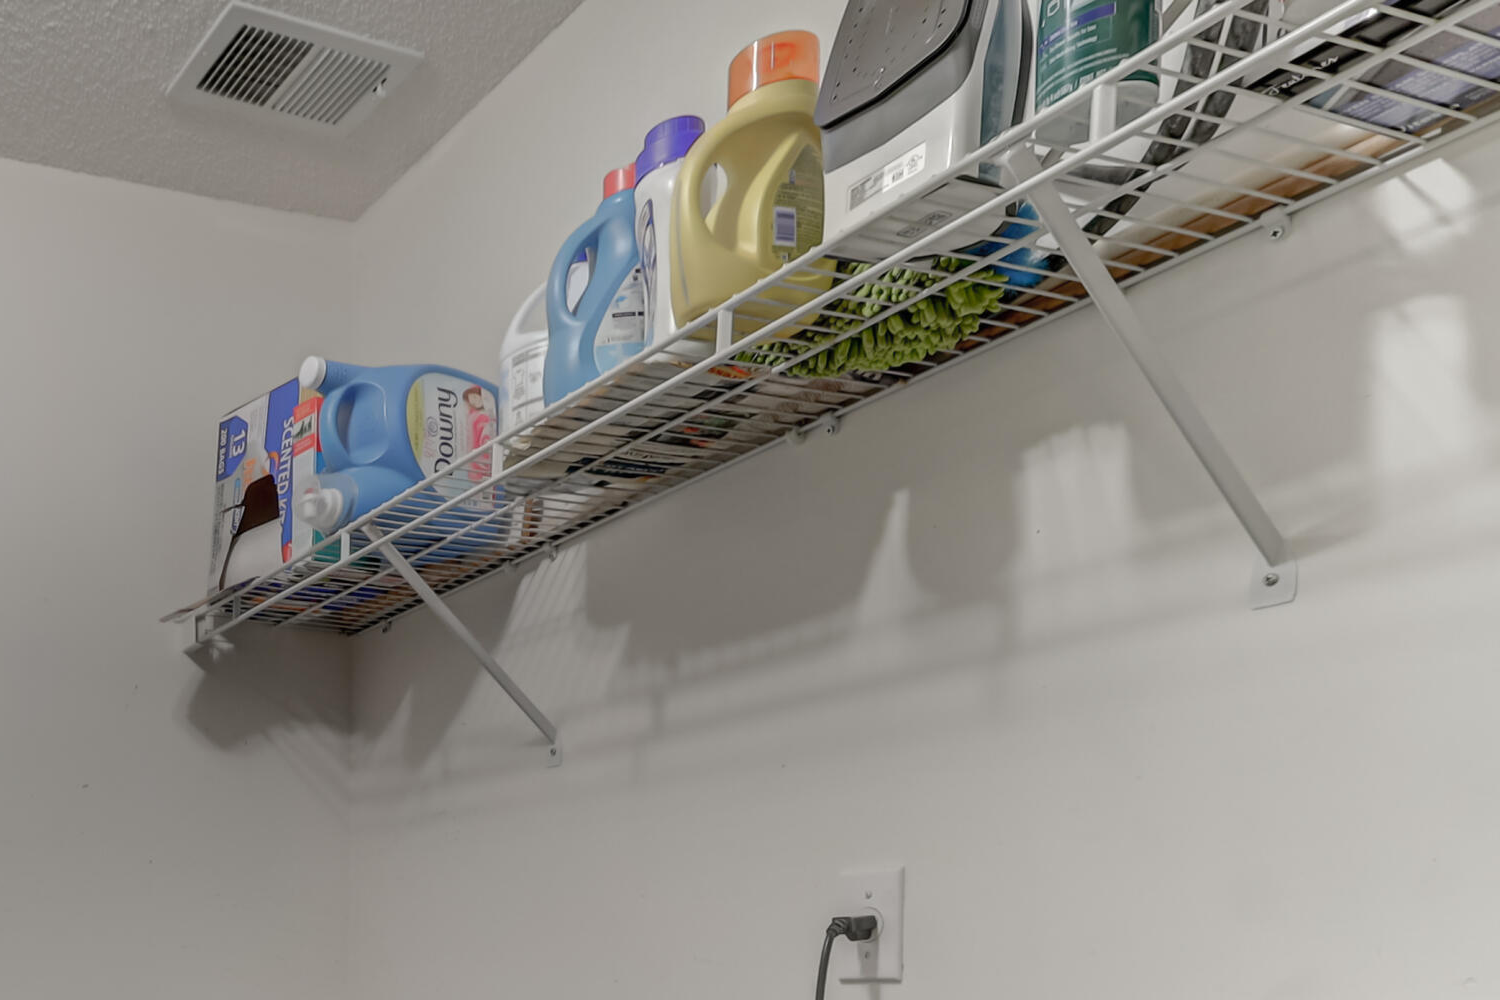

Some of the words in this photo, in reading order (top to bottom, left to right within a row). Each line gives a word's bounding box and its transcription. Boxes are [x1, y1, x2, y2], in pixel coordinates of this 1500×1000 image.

[230, 428, 247, 457] 13
[277, 416, 295, 495] SCENTED
[434, 386, 458, 477] Downy
[218, 448, 226, 475] BAGS
